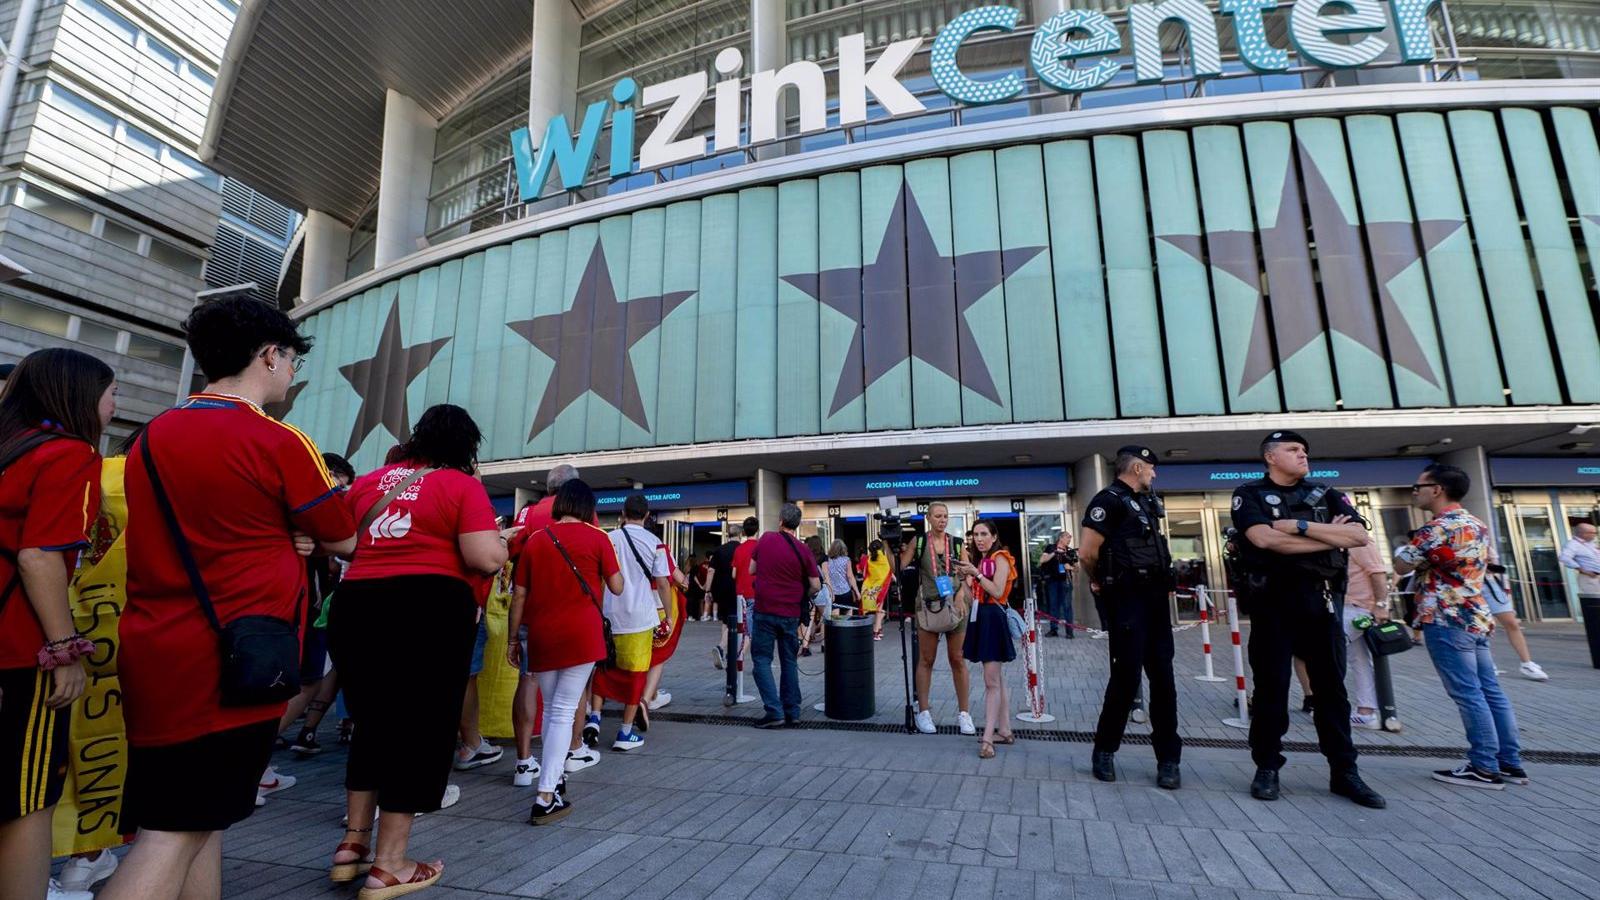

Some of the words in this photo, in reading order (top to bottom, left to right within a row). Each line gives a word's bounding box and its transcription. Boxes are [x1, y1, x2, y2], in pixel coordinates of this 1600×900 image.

[1210, 472, 1240, 480] ACCESO
[1312, 470, 1340, 478] AFORO
[915, 479, 954, 487] COMPLETAR
[955, 478, 980, 486] AFORO
[918, 504, 929, 513] 02
[1013, 501, 1024, 510] 01
[717, 511, 727, 519] 04
[828, 507, 840, 516] 03
[78, 736, 121, 836] UNAS
